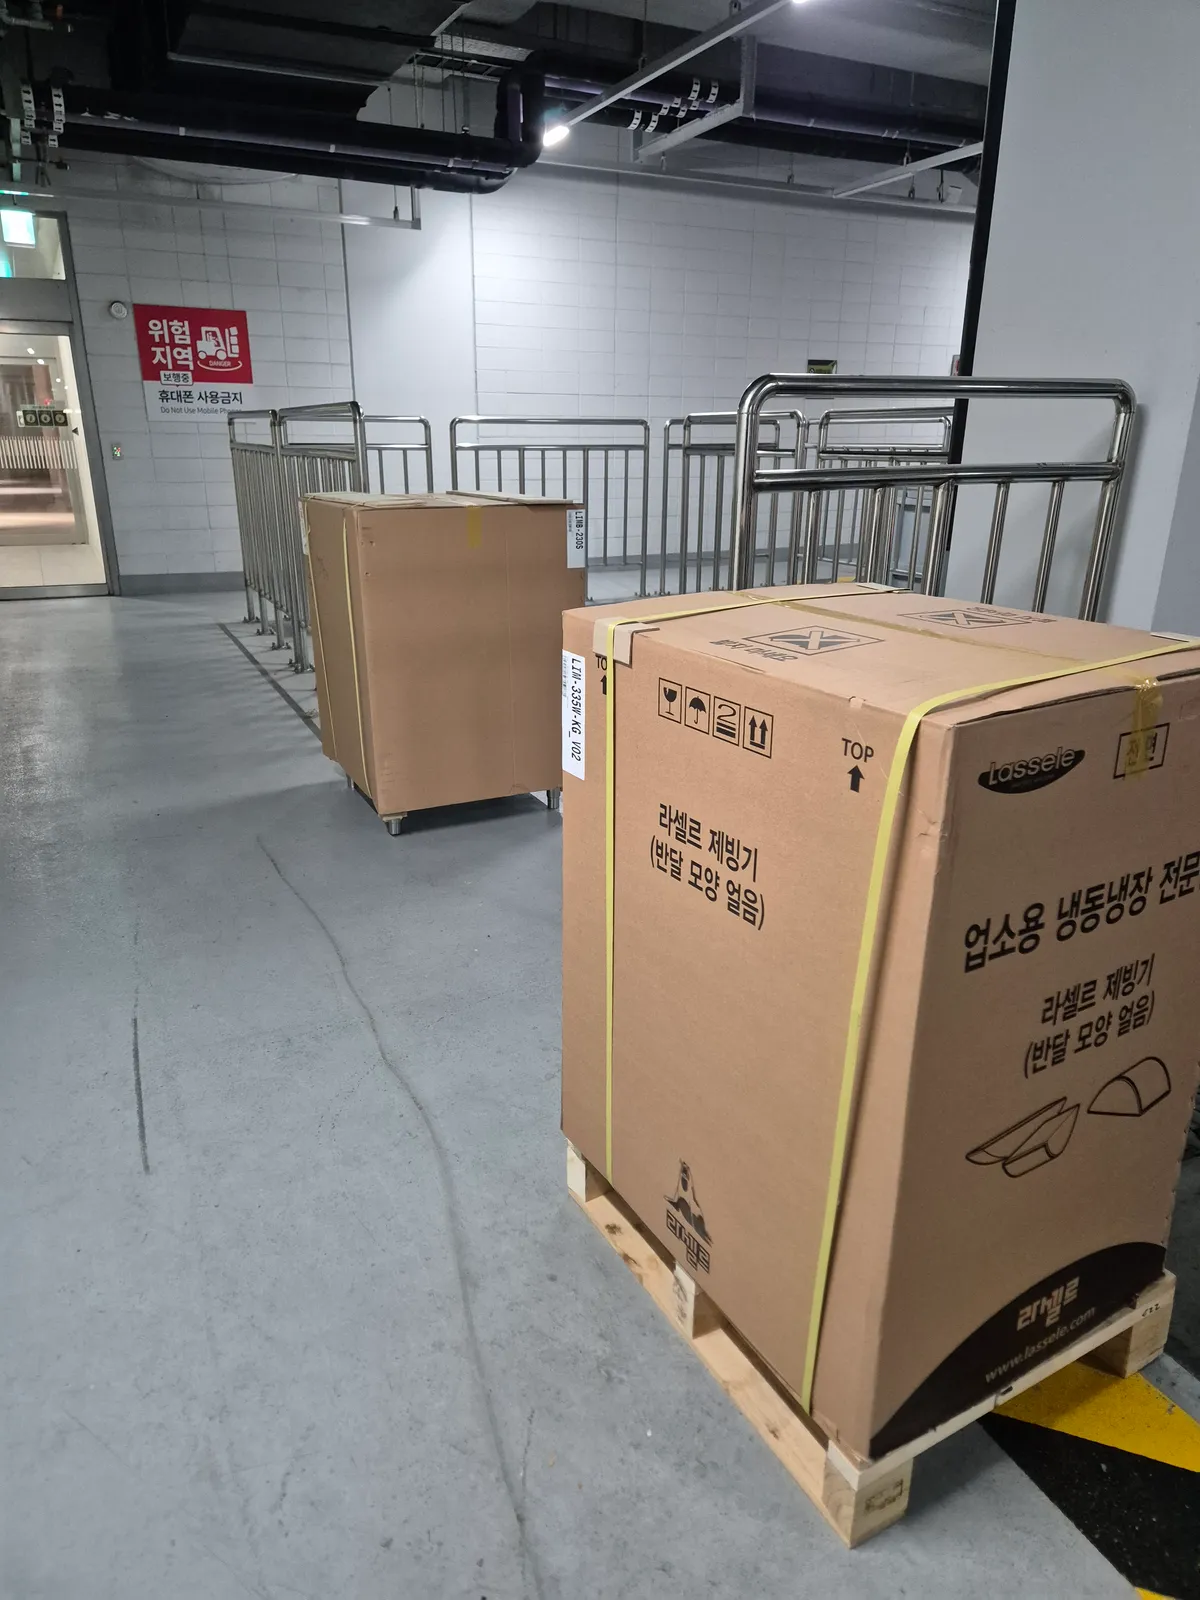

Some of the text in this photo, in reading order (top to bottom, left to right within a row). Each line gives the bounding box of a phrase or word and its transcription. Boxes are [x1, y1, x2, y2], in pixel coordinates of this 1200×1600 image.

[148, 319, 191, 345] 위험
[151, 345, 194, 370] 지역
[158, 390, 243, 404] 휴대폰 사용금지
[163, 372, 190, 383] 보행중
[160, 406, 170, 414] Do
[841, 737, 875, 763] TOP
[658, 802, 758, 883] 라셀르 제빙기
[650, 835, 765, 931] (반달 모양 얼음)
[964, 850, 1200, 974] 업소용 냉동냉장 전문
[1040, 952, 1156, 1026] 라셀르 제빙기
[1023, 990, 1155, 1079] (반달 모양 얼음)
[1016, 1275, 1080, 1332] 라셀르
[985, 1307, 1096, 1383] www.lassele.com
